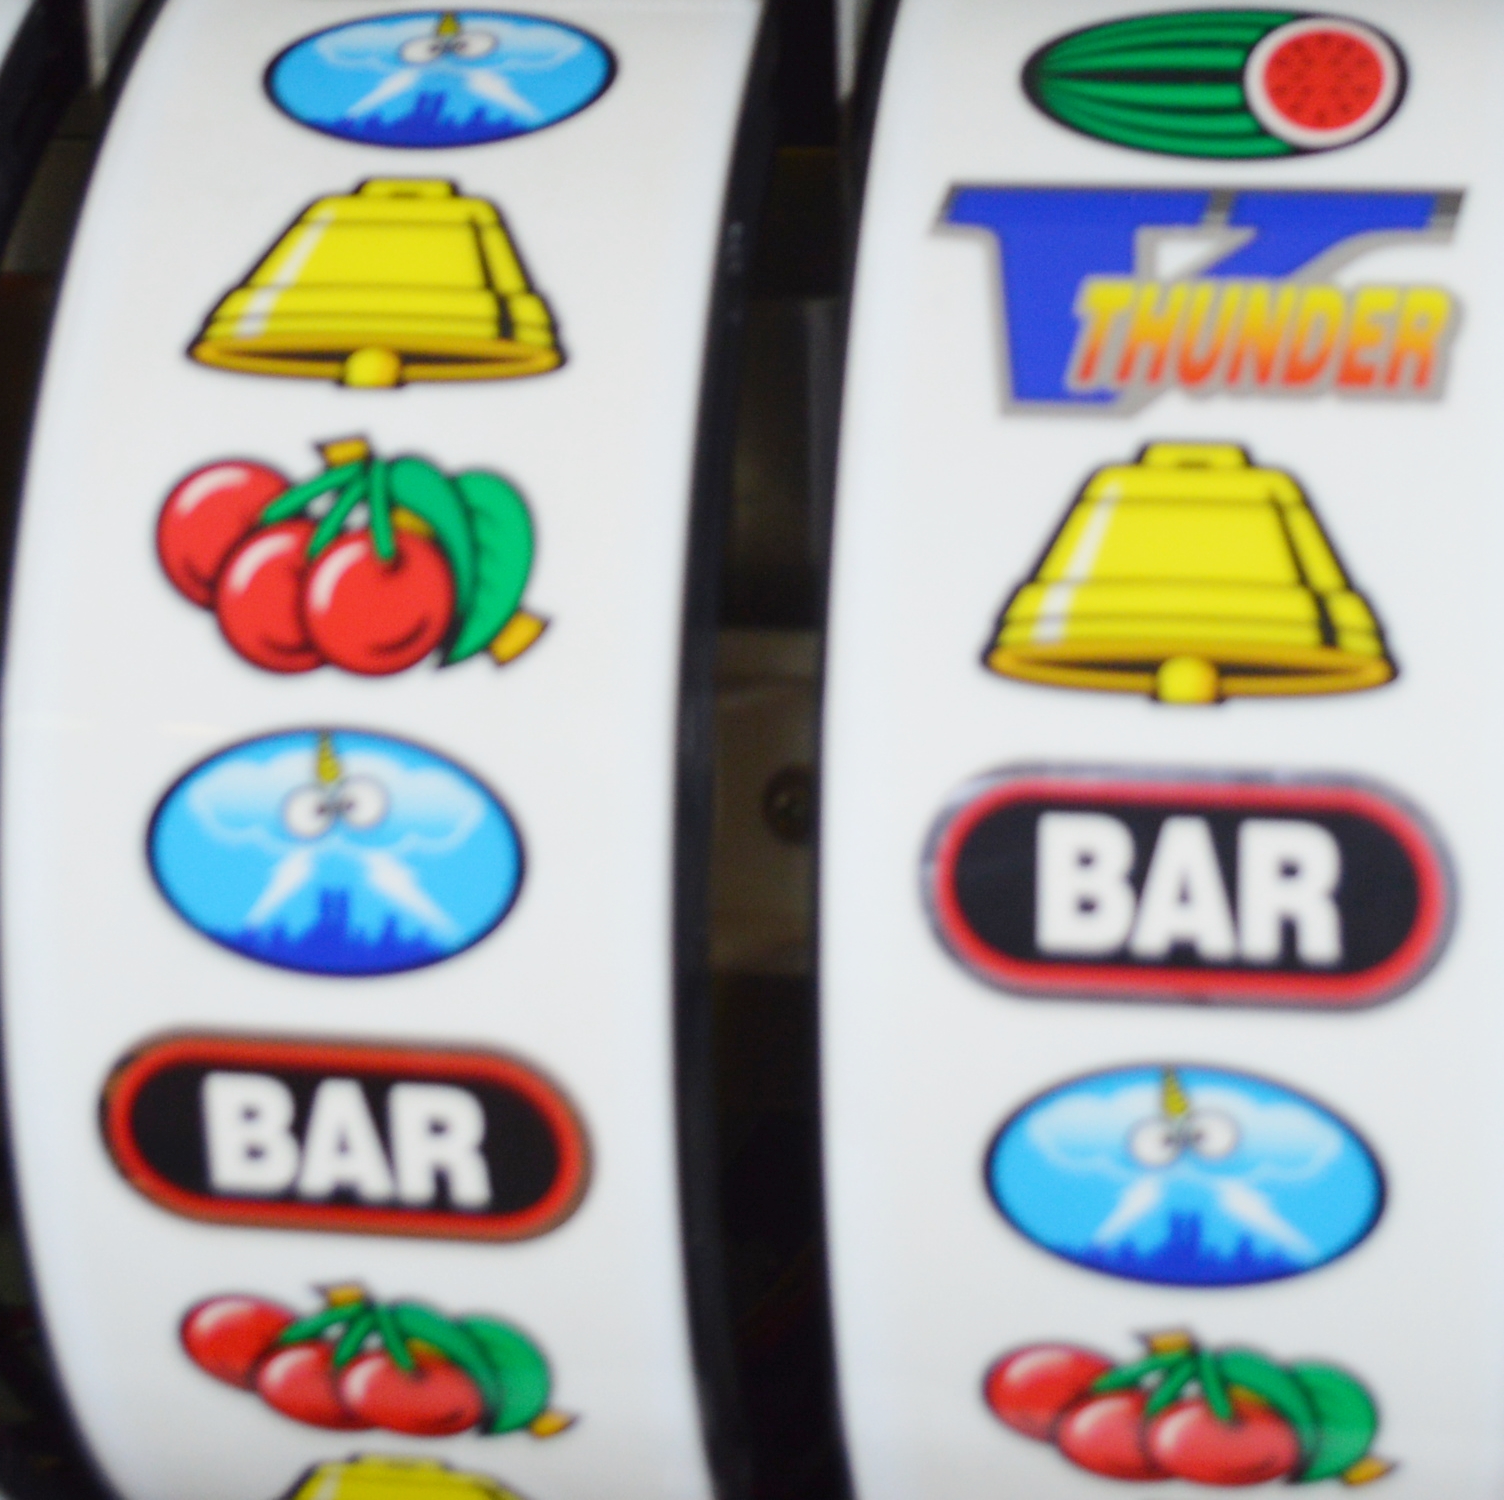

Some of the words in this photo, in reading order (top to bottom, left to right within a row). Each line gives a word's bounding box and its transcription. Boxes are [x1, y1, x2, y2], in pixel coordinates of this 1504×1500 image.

[1068, 282, 1458, 393] THUNDER
[1034, 812, 1344, 966] BAR
[200, 1071, 492, 1208] BAR
